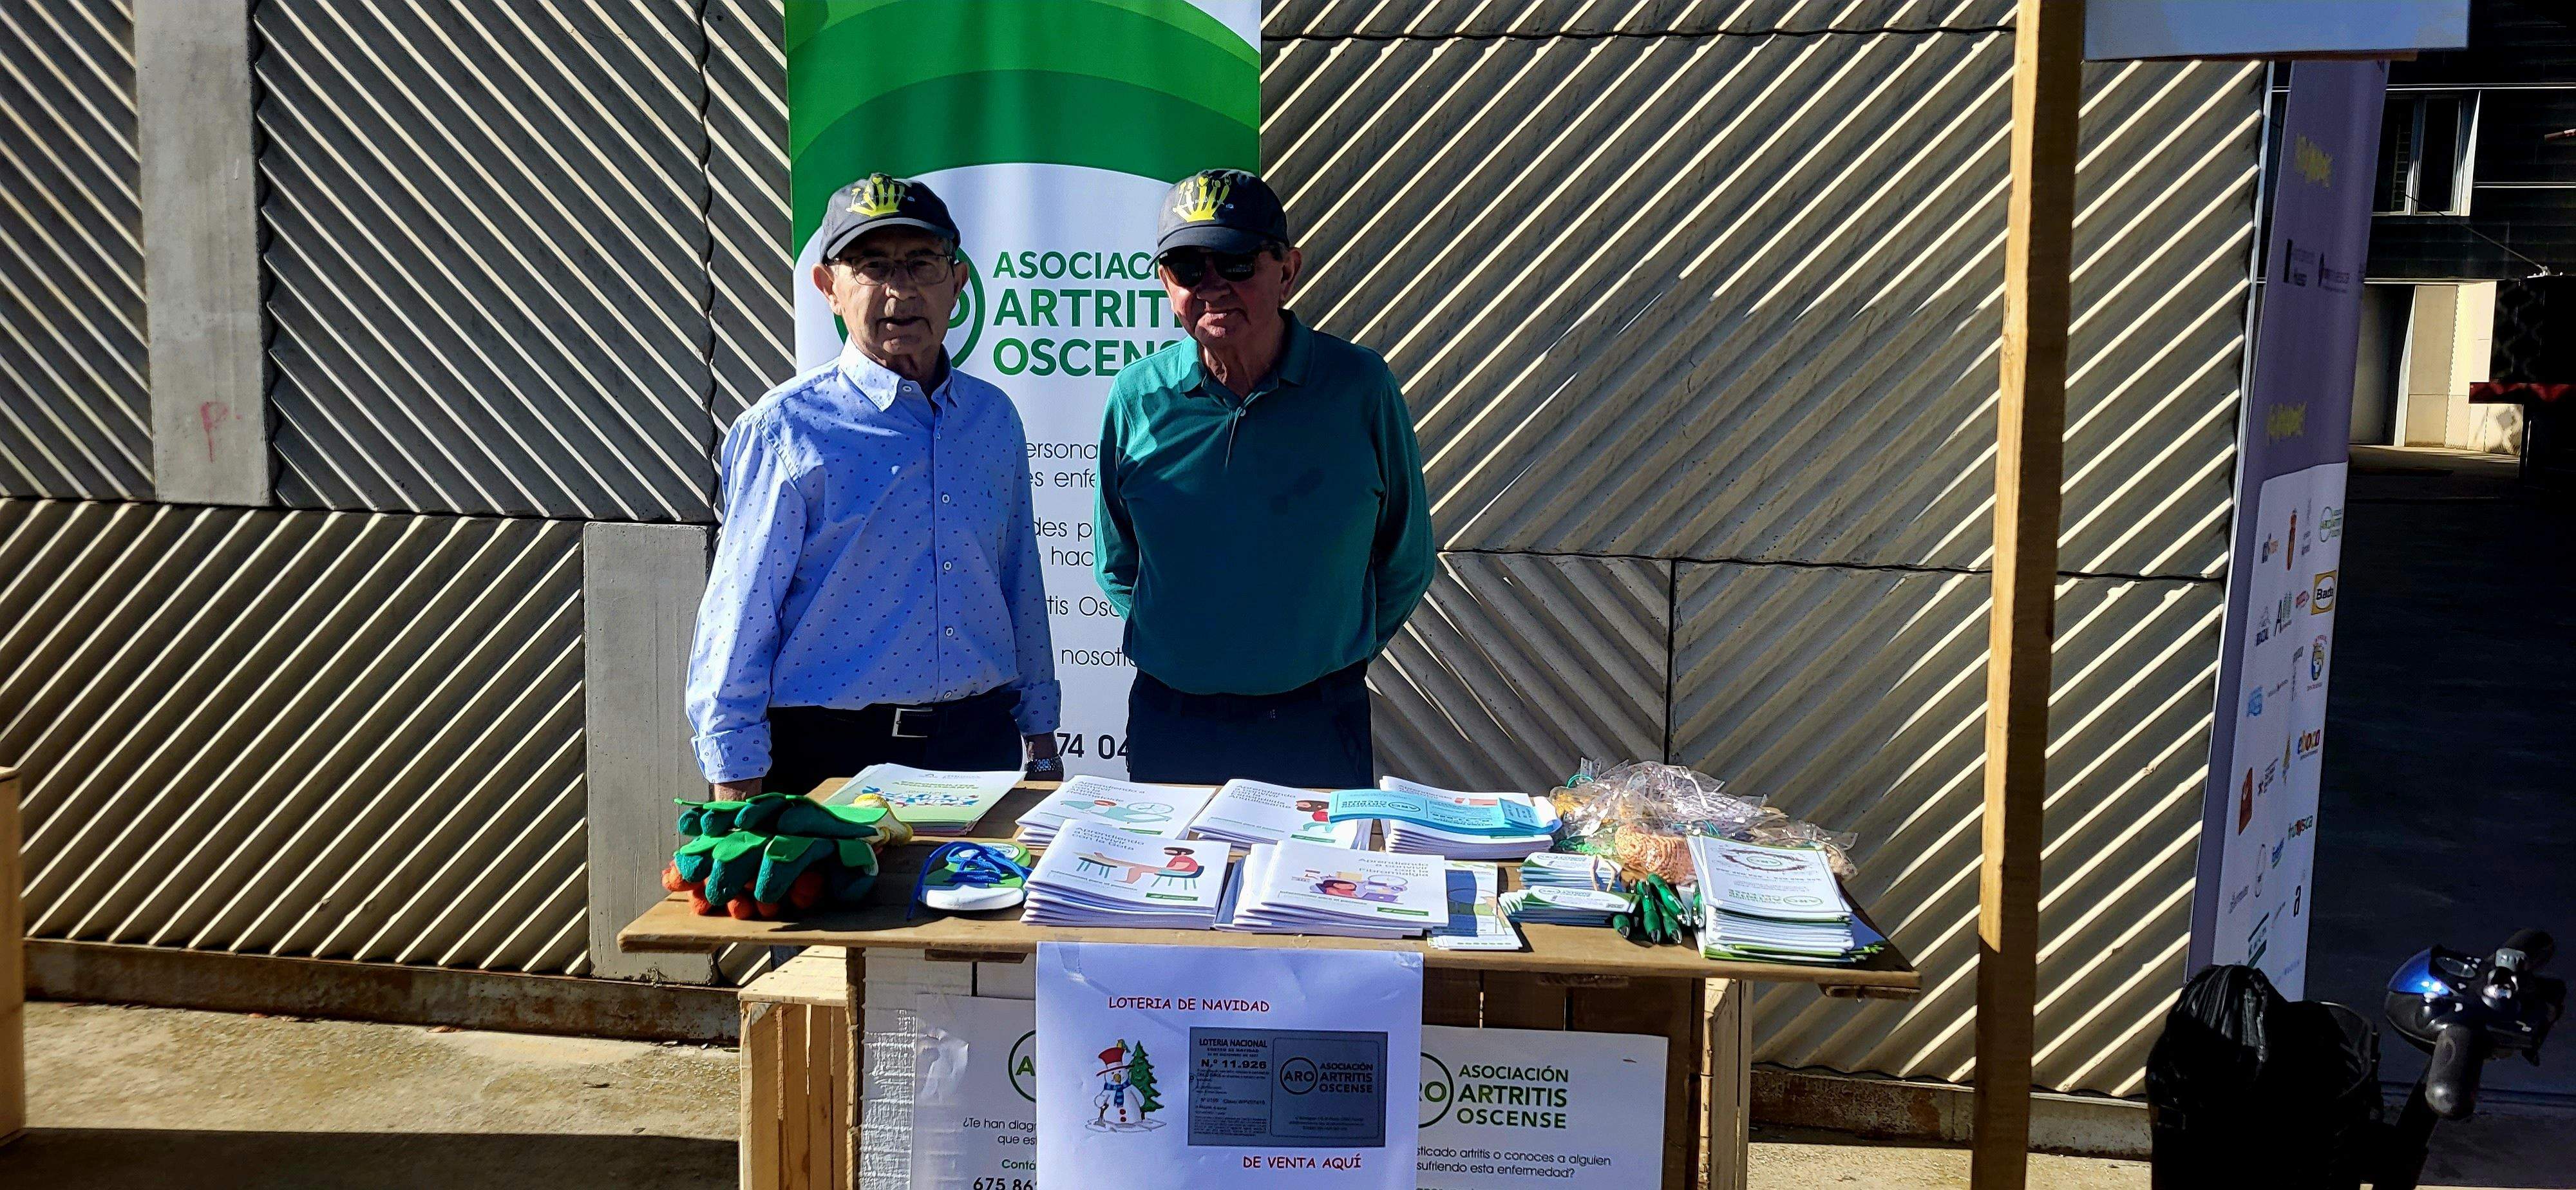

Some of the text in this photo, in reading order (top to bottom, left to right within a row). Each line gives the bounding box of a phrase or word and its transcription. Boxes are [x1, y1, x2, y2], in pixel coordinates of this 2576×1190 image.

[993, 251, 1160, 279] ASOCIACI
[993, 289, 1182, 328] ARTRIT
[1027, 442, 1098, 459] ersona
[1034, 517, 1067, 537] des
[1046, 595, 1068, 615] tis
[1057, 733, 1084, 758] 74
[1109, 996, 1270, 1012] LOTERIA DE NAVIDAD
[1199, 1037, 1268, 1048] LOTERIA NACIONAL
[1222, 1060, 1267, 1069] 11.926
[1320, 1062, 1374, 1071] ASOCIACIÓN
[1283, 1070, 1316, 1082] ARO
[1320, 1072, 1373, 1083] ARTRITIS
[1459, 1064, 1569, 1082] ASOCIACIÓN
[1319, 1083, 1373, 1093] OSCENSE
[1457, 1084, 1567, 1108] ARTRITIS
[963, 1117, 1036, 1133] ¿Te han diag
[1457, 1108, 1567, 1129] OSCENSE
[998, 1135, 1020, 1146] que
[1243, 1153, 1361, 1171] DE VENTA AQUÍ
[1417, 1146, 1611, 1167] sticado artritis o conoces a alguien
[1001, 1159, 1036, 1171] Contá
[1470, 1163, 1495, 1174] esta
[1497, 1165, 1575, 1178] enfermedad?
